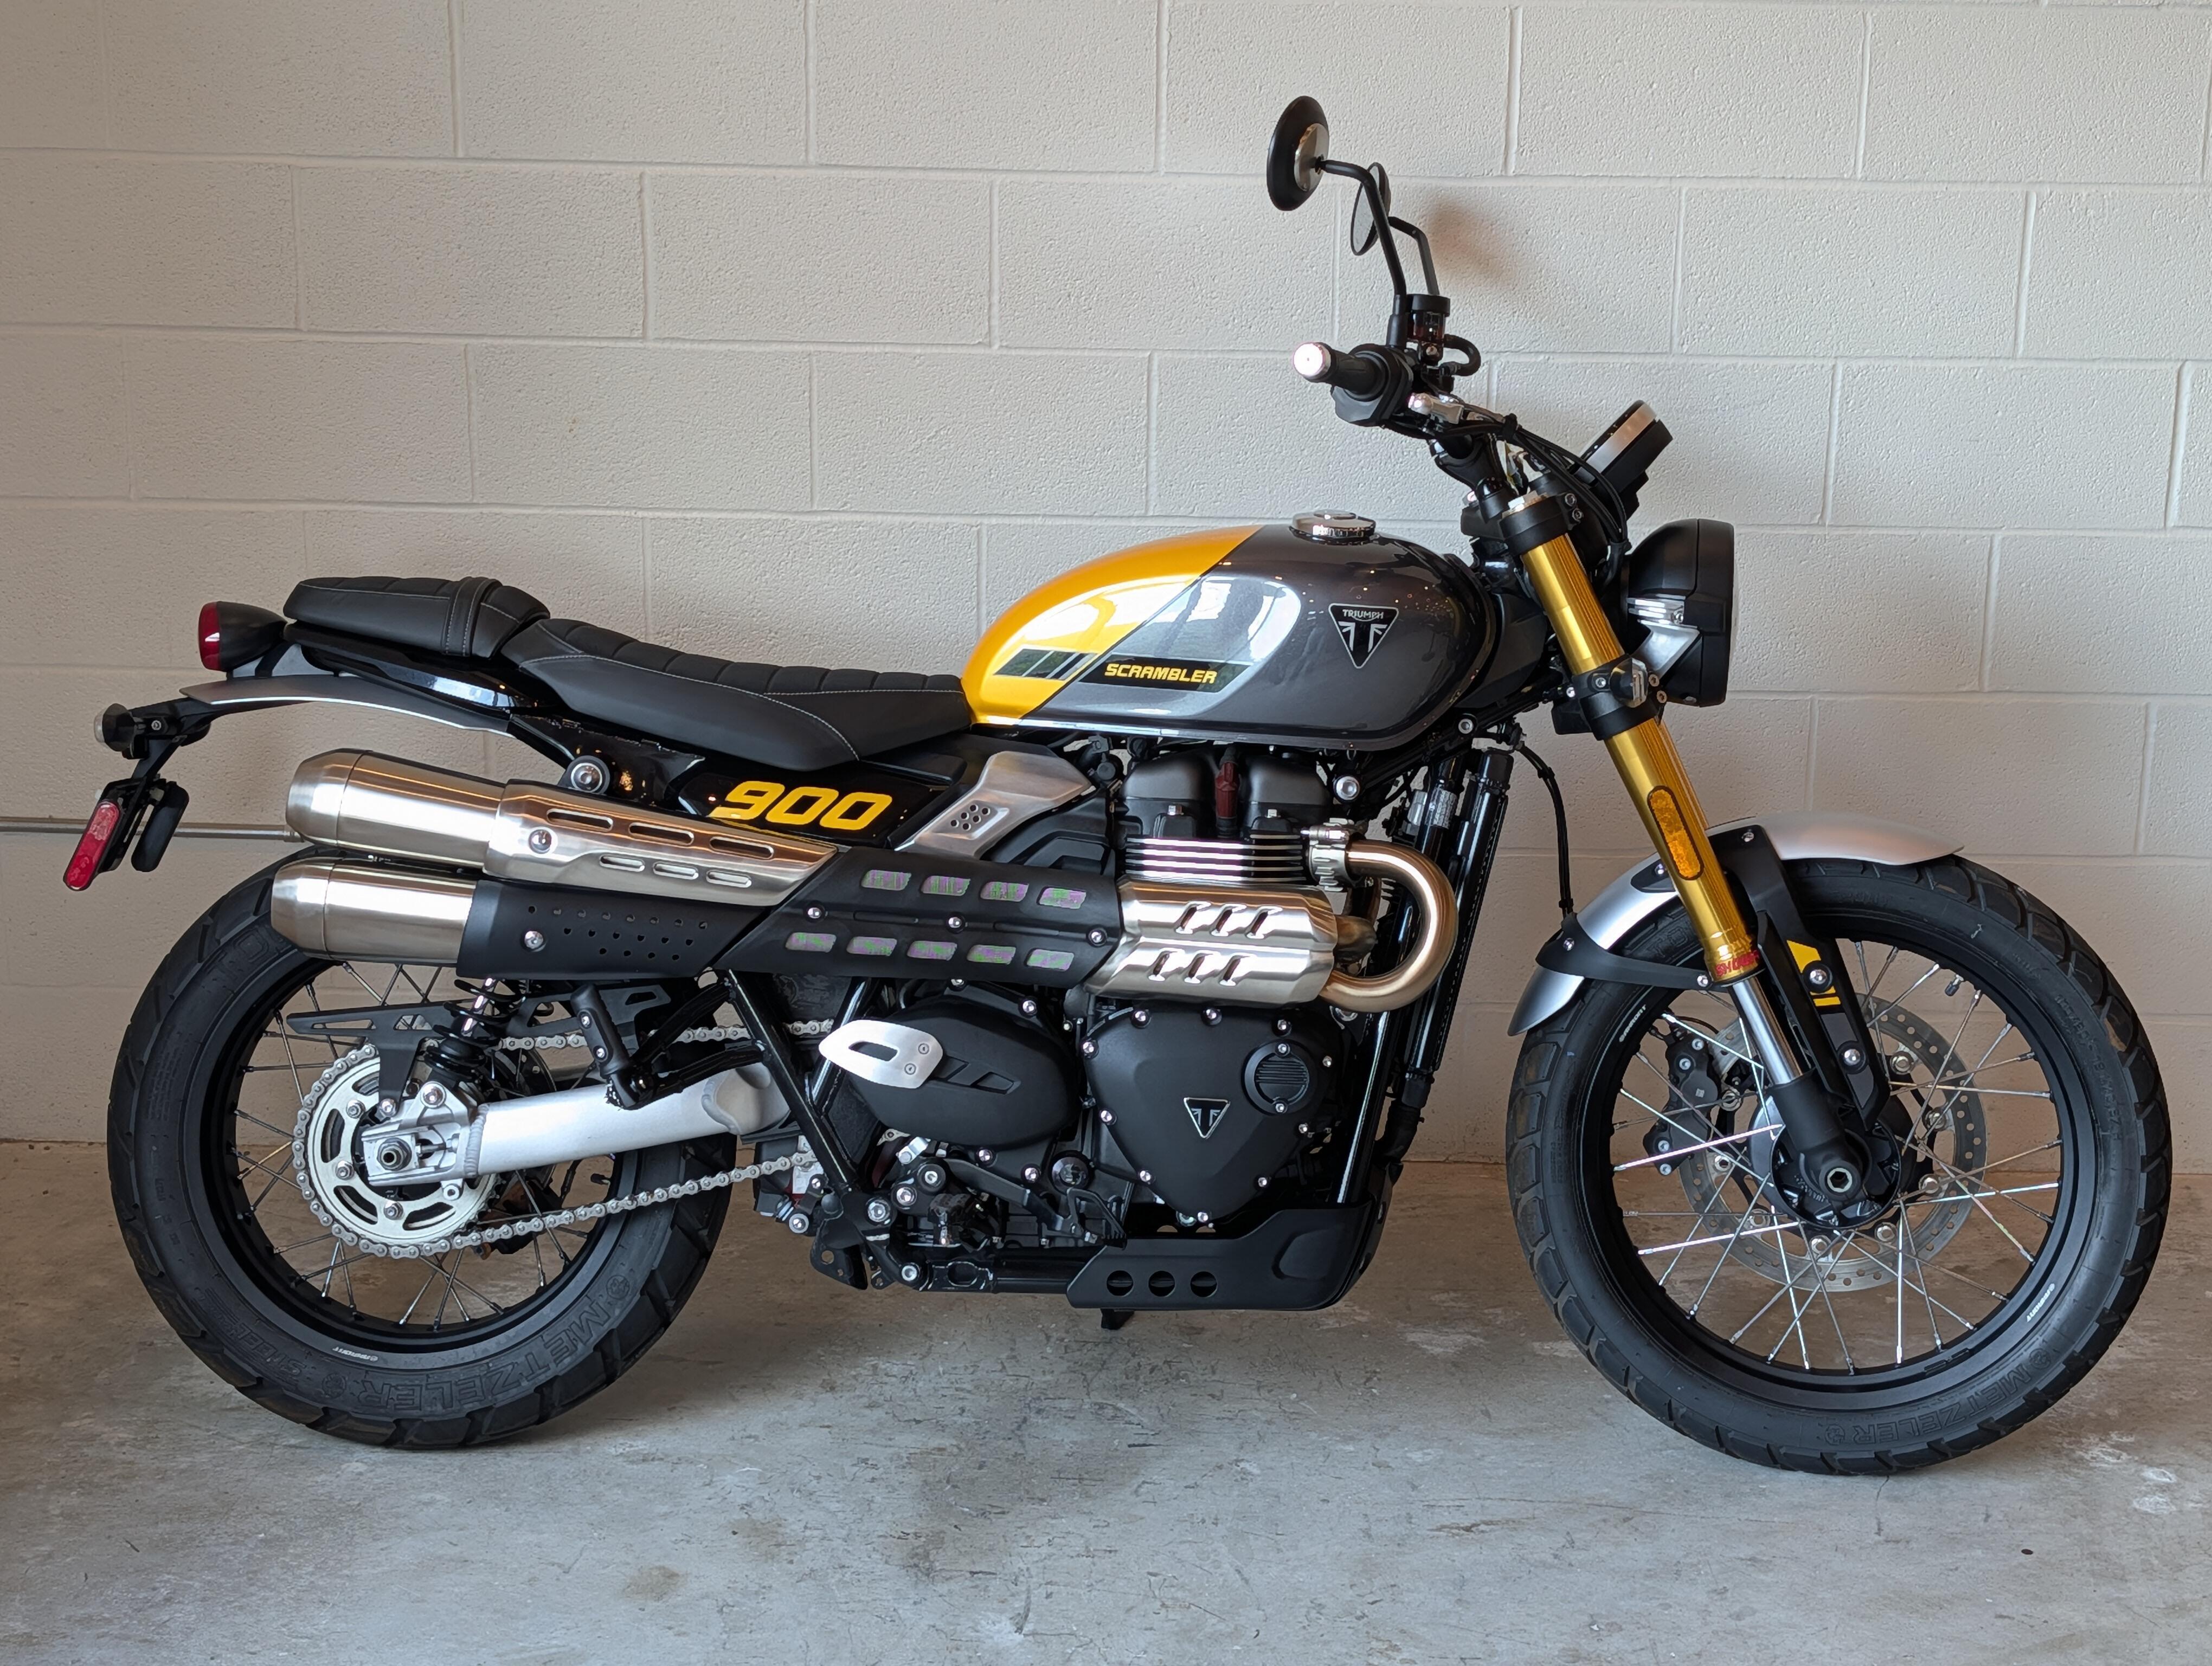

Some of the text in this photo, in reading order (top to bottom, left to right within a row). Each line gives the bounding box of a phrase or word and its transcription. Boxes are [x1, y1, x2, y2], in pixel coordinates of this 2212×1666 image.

[1342, 608, 1384, 621] TRIUMPH
[1104, 663, 1218, 685] SCRAMBLER
[707, 780, 893, 831] 900
[358, 1300, 610, 1411] METZELER
[1853, 1362, 2031, 1445] METZELER
